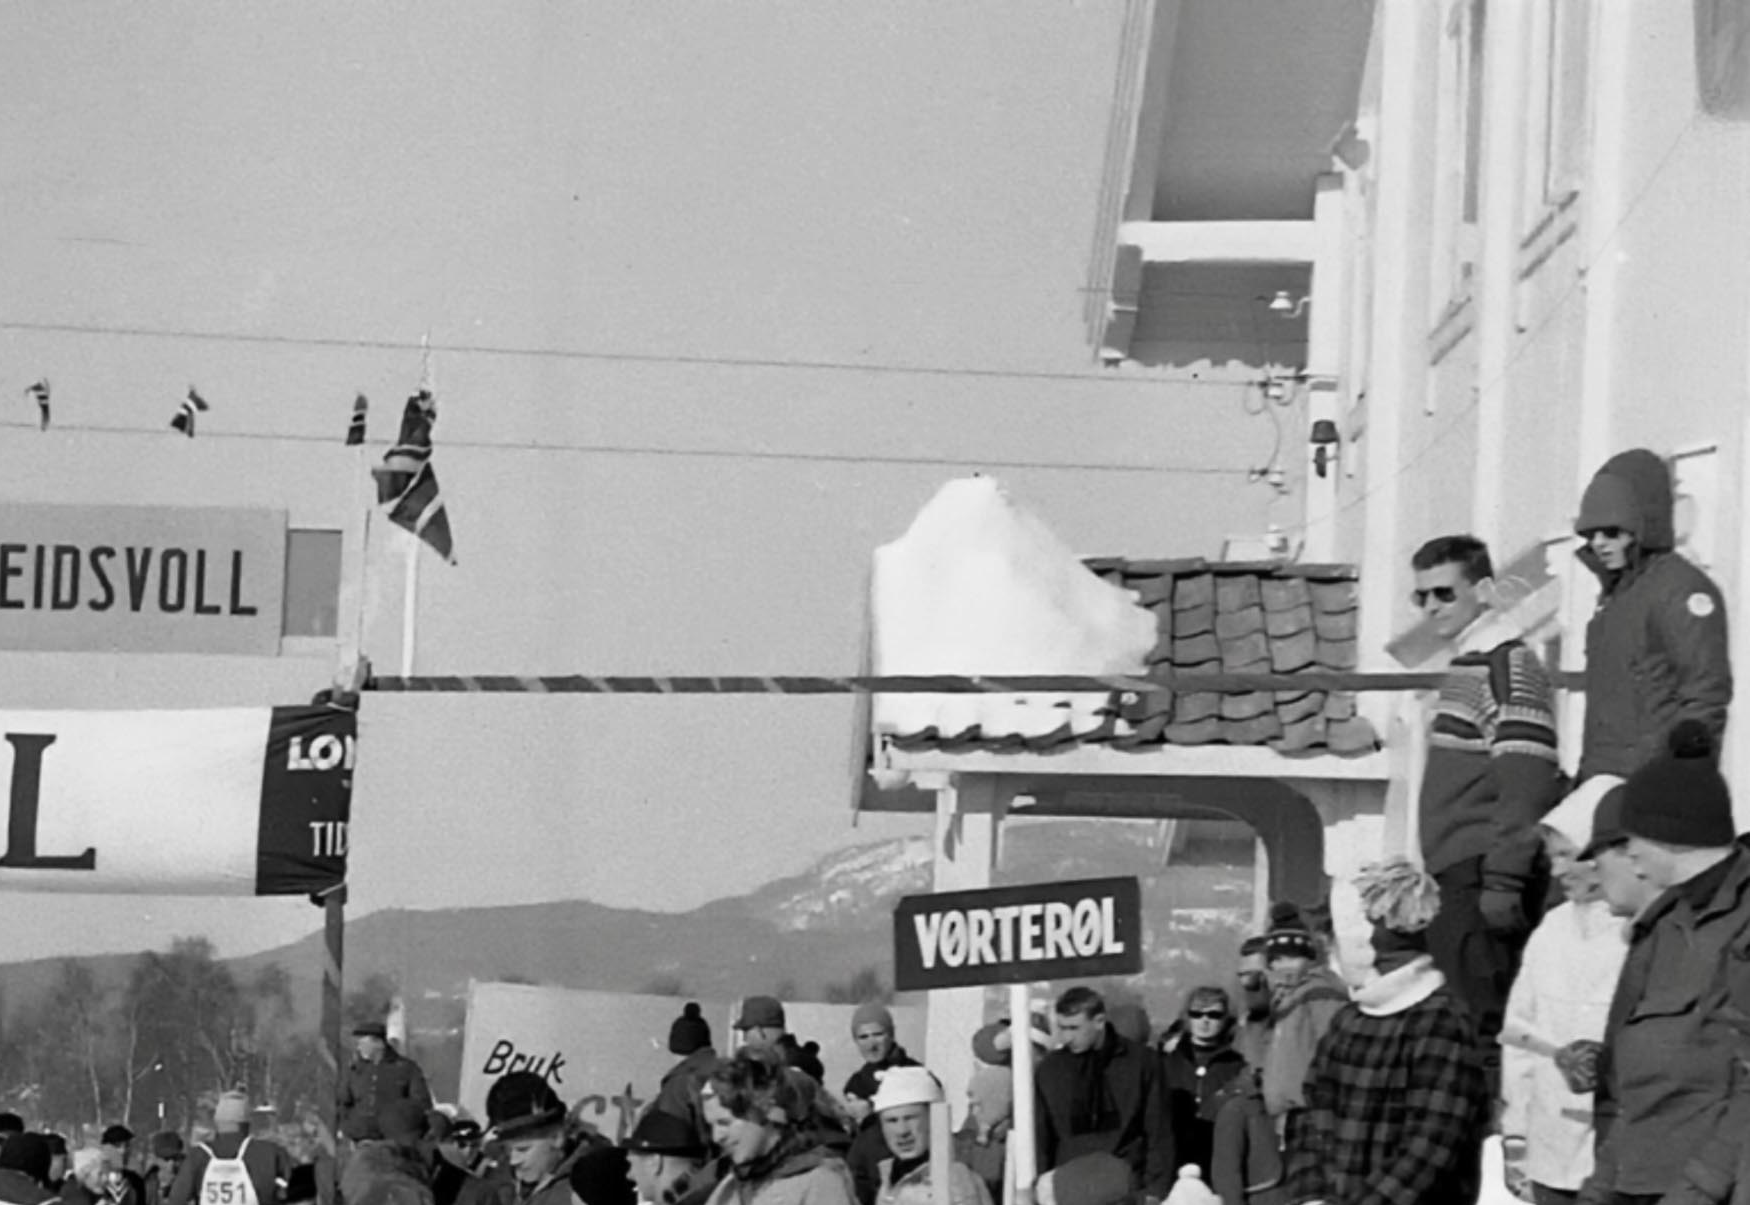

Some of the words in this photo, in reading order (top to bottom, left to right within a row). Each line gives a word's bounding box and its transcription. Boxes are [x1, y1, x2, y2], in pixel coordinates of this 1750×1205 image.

[913, 896, 1124, 969] VØRTERØL
[482, 1039, 567, 1084] Bruk
[206, 1181, 247, 1205] 551
